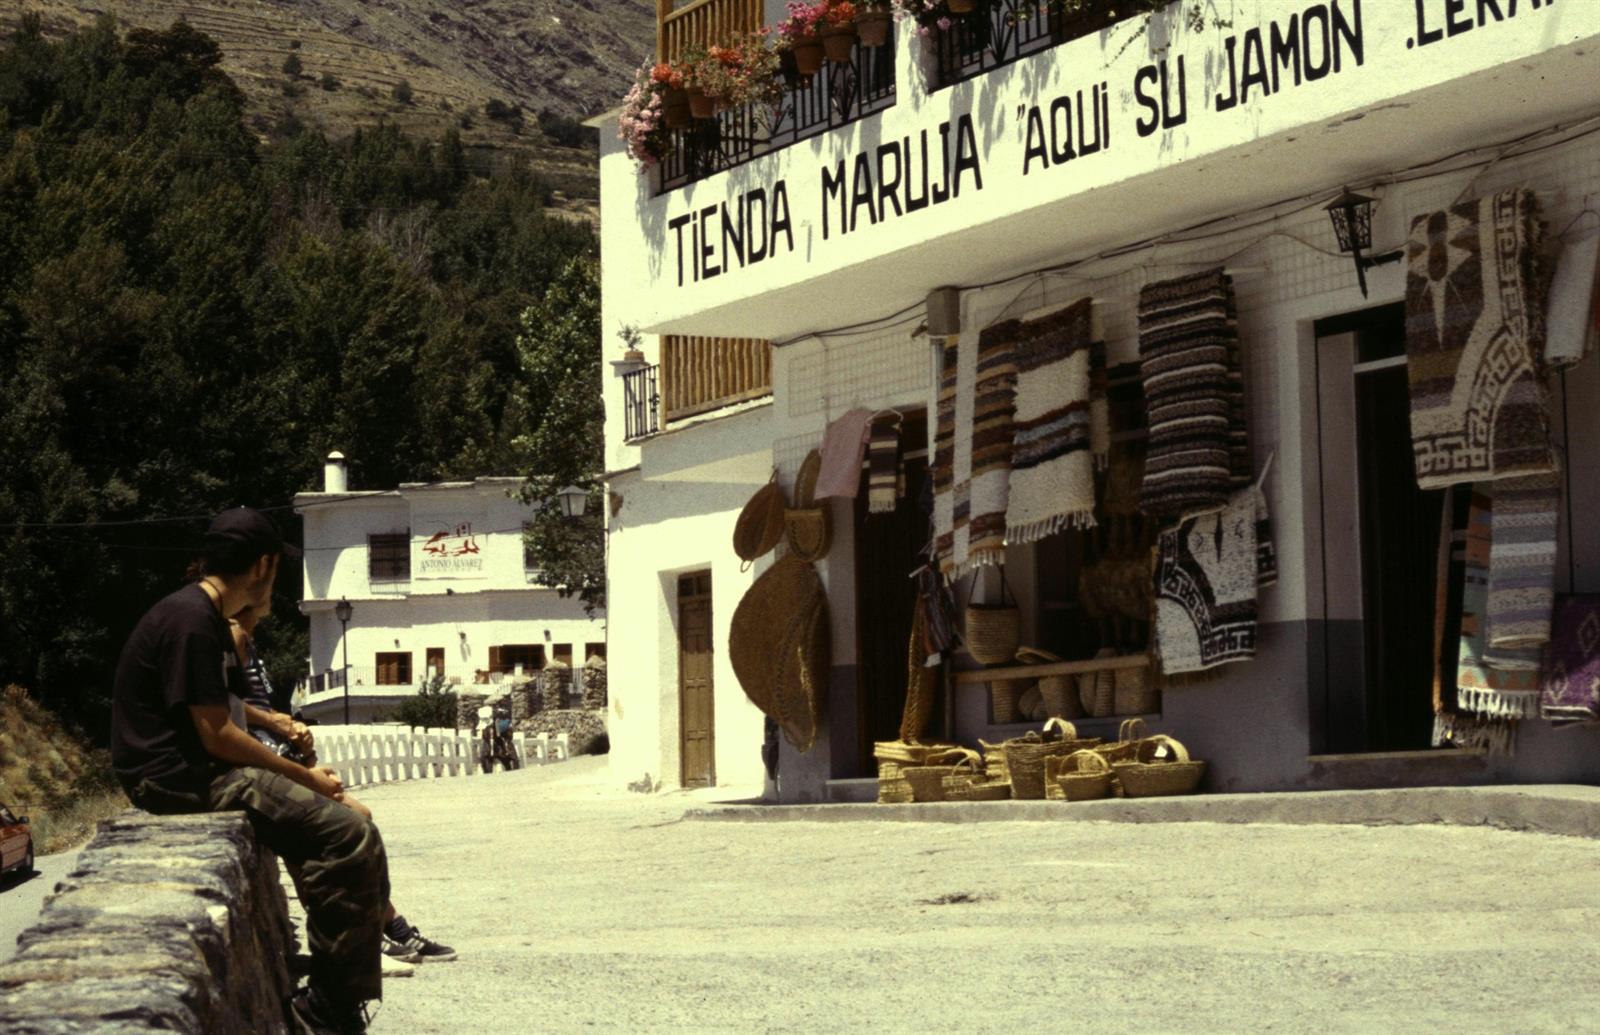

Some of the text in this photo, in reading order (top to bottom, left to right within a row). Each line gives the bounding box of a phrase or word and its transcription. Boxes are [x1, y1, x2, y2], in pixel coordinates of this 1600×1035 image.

[821, 112, 983, 240] MARUJA
[1134, 54, 1187, 138] SU
[1215, 0, 1365, 112] JAMON
